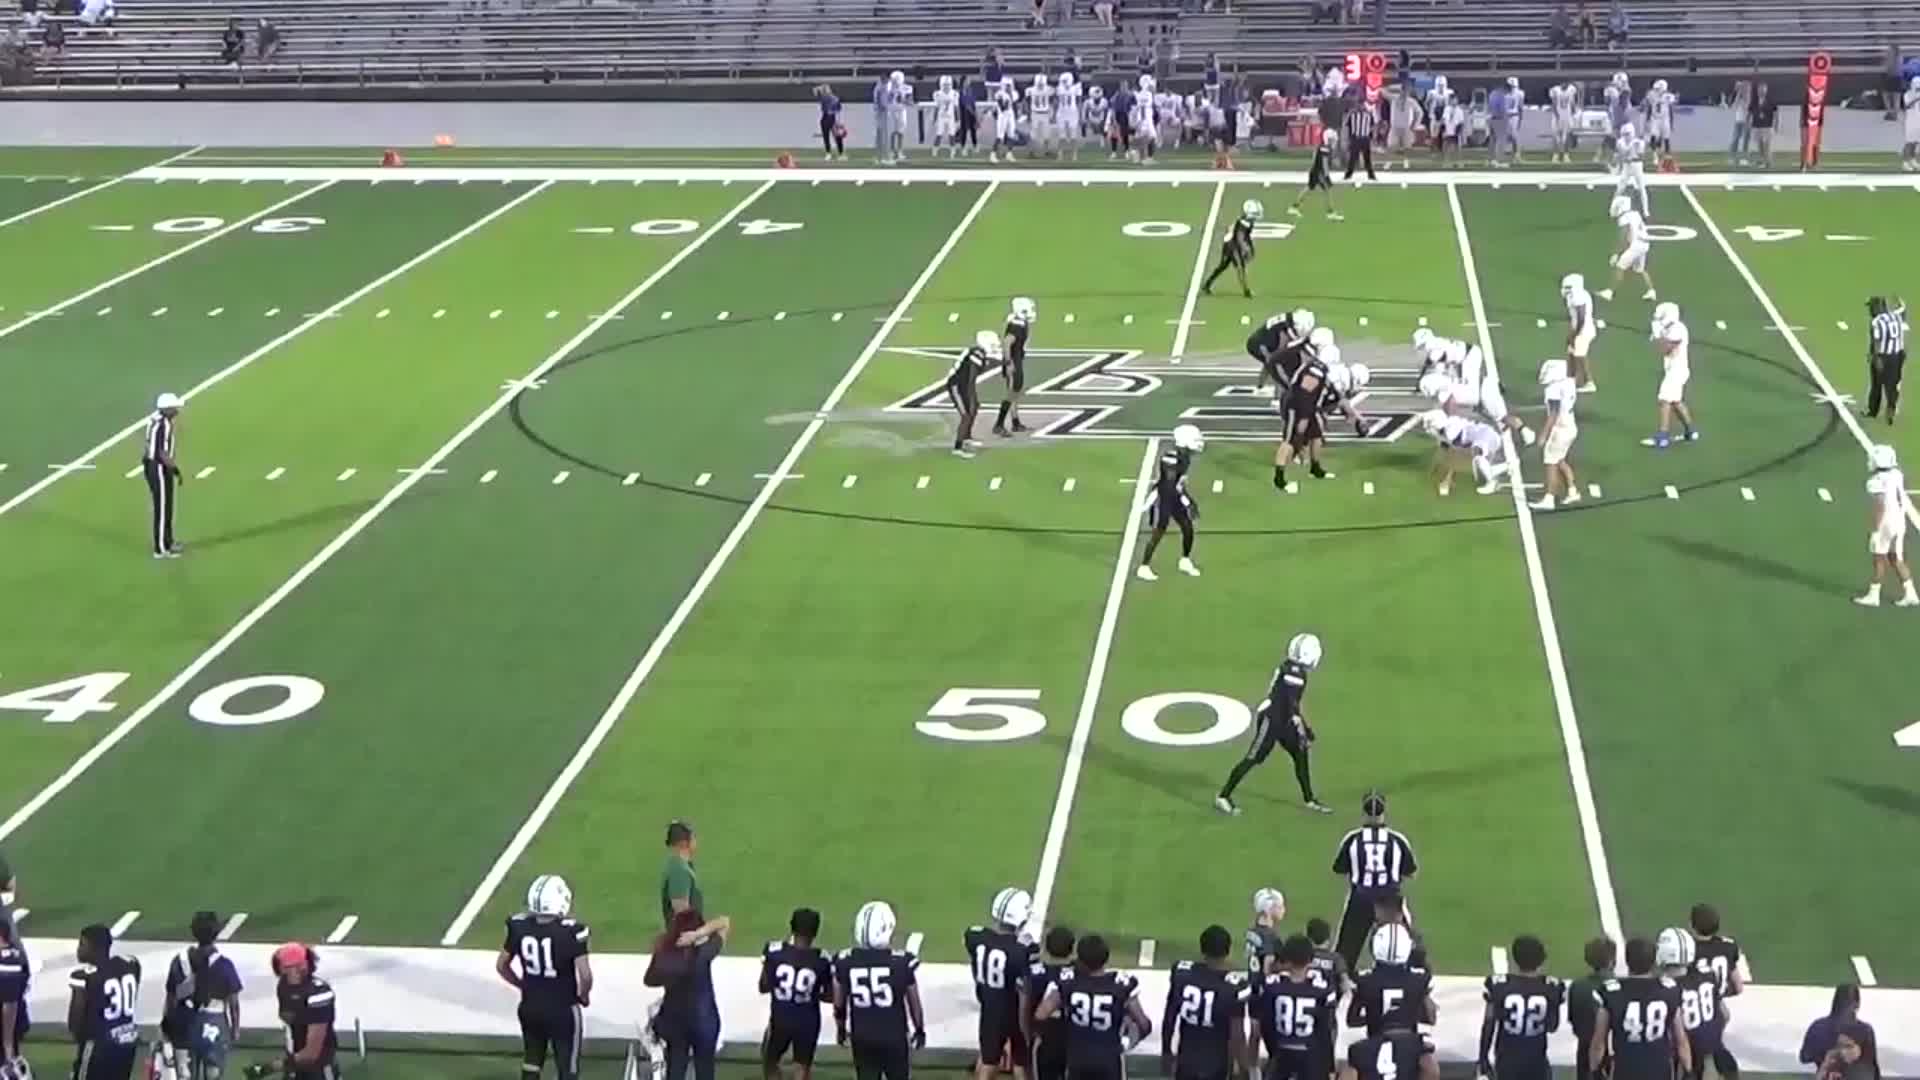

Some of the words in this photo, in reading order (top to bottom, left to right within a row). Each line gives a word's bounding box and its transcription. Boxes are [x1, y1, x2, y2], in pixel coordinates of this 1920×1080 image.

[1345, 54, 1361, 80] 3
[1364, 843, 1387, 872] H
[521, 935, 558, 978] 91
[976, 944, 1007, 989] 18
[103, 974, 136, 1020] 30
[774, 964, 817, 1004] 39
[850, 967, 893, 1008] 55
[1070, 992, 1113, 1031] 35
[1180, 984, 1215, 1027] 21
[1275, 995, 1316, 1037] 85
[1504, 993, 1547, 1036] 32
[1623, 1000, 1668, 1042] 48
[1681, 981, 1714, 1030] 88
